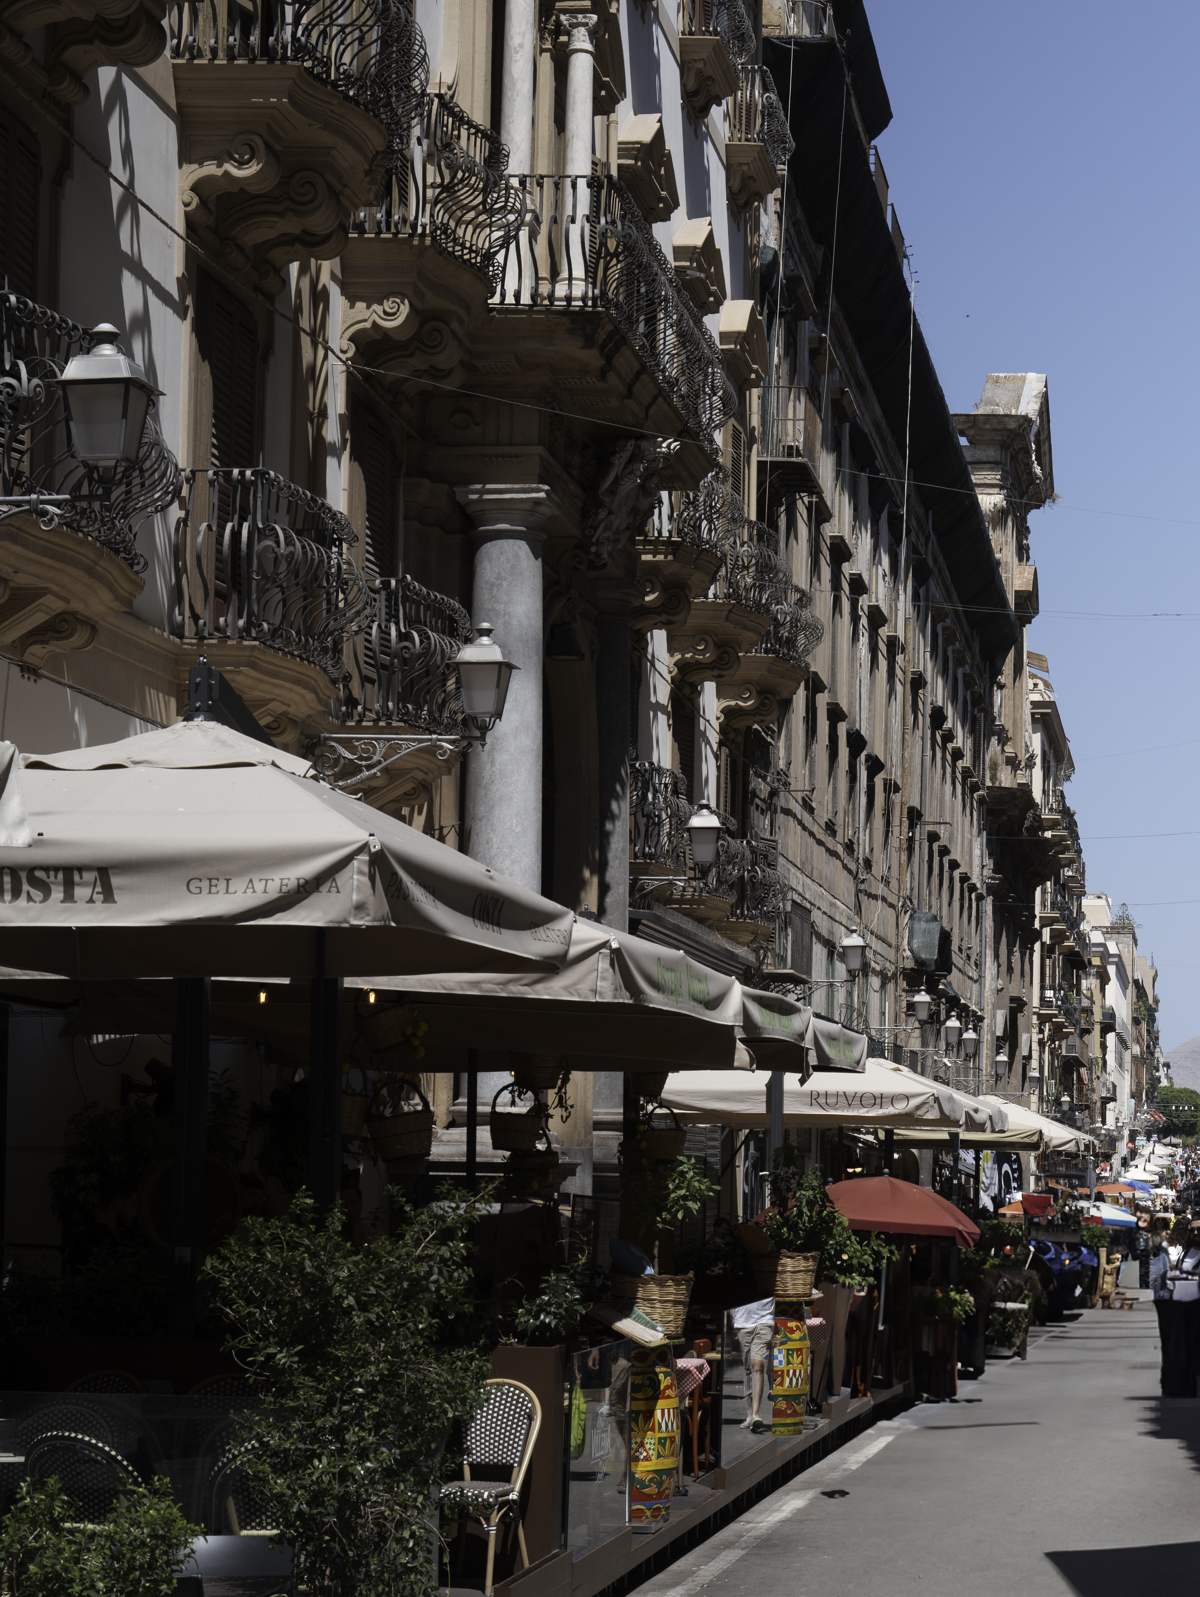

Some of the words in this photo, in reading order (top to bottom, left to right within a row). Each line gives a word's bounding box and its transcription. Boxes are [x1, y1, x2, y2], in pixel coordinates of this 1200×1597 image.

[186, 877, 341, 895] GELATERIA
[472, 892, 505, 935] COSTA
[809, 1090, 910, 1112] RUVOLO
